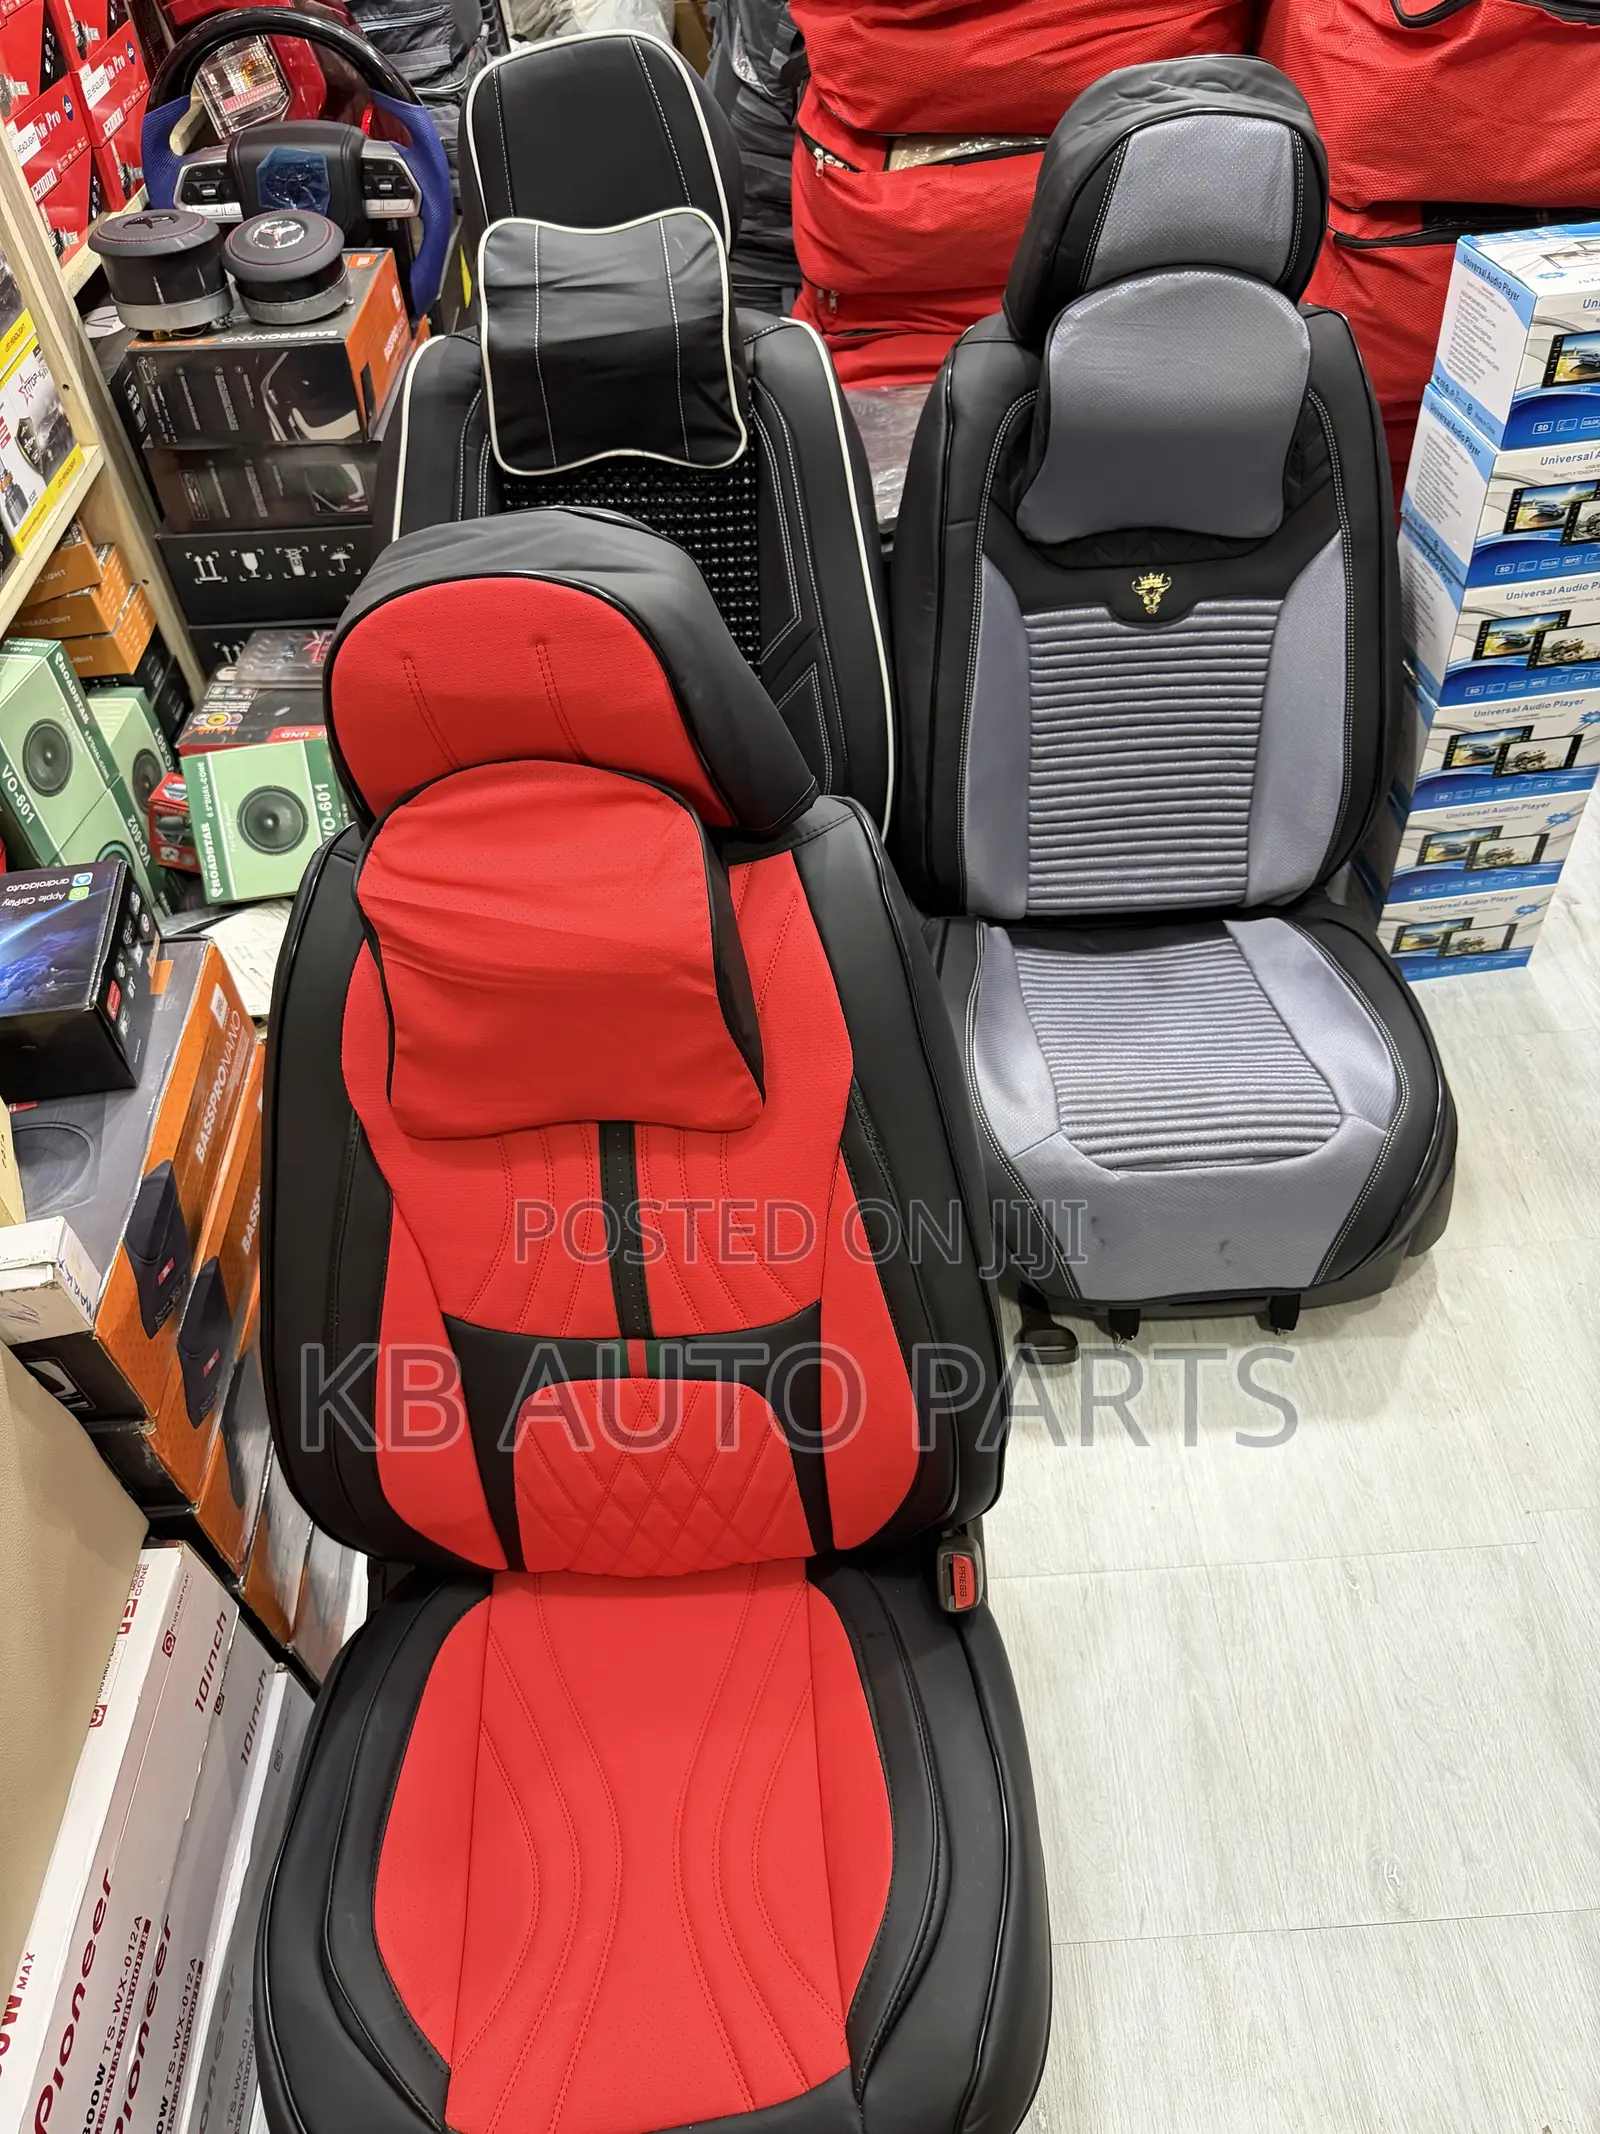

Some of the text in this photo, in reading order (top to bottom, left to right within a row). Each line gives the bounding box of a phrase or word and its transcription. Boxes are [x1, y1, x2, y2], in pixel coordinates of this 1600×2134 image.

[45, 110, 61, 131] Pro
[1463, 254, 1521, 301] Universal Audio Player
[1540, 451, 1594, 466] Universal
[1506, 583, 1589, 601] Universal Audio
[58, 660, 90, 724] ROADSTAR
[1474, 698, 1586, 718] Universal Audio Player
[2, 764, 35, 825] VO-601
[1446, 802, 1551, 819] Universal Audio Player
[128, 814, 151, 868] VO-602
[201, 822, 223, 889] ROADSTAR
[1, 892, 66, 907] Apple CarPlay
[6, 878, 70, 892] androidauto
[195, 1010, 241, 1164] BASSPRONANO
[134, 1563, 150, 1597] CONE
[171, 1574, 190, 1632] PLUG AND PLAY
[959, 1566, 968, 1597] PRESS
[195, 1611, 227, 1713] 10inch
[240, 1668, 267, 1766] 10inch
[16, 1952, 35, 1990] MAX
[103, 1915, 143, 2054] TS-WX-012A
[34, 1868, 111, 2134] Pioneer
[165, 1957, 198, 2088] TS-WX-012A
